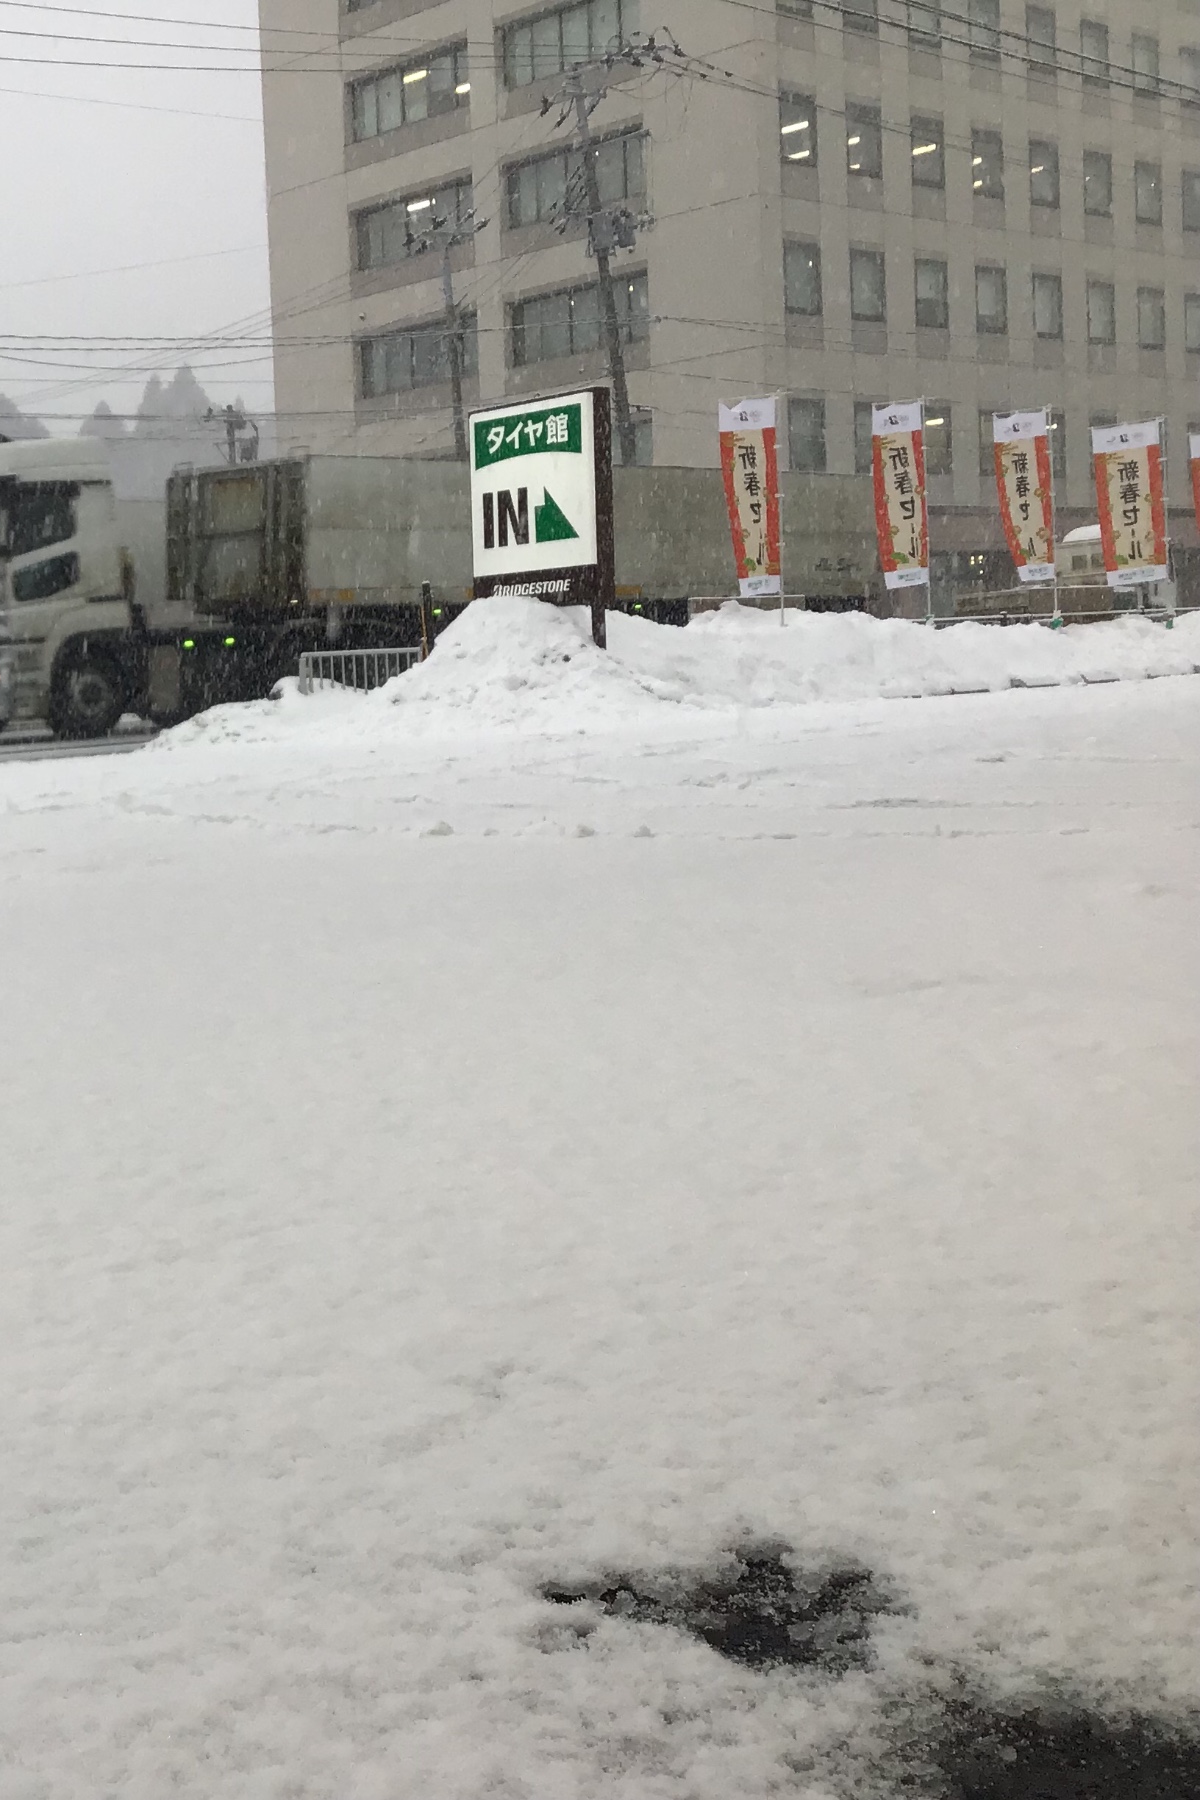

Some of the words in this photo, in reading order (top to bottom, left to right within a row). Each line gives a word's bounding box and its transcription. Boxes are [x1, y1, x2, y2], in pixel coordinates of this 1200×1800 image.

[486, 413, 569, 454] タイヤ館
[482, 486, 530, 549] IN
[493, 578, 571, 597] BRIDGESTONE
